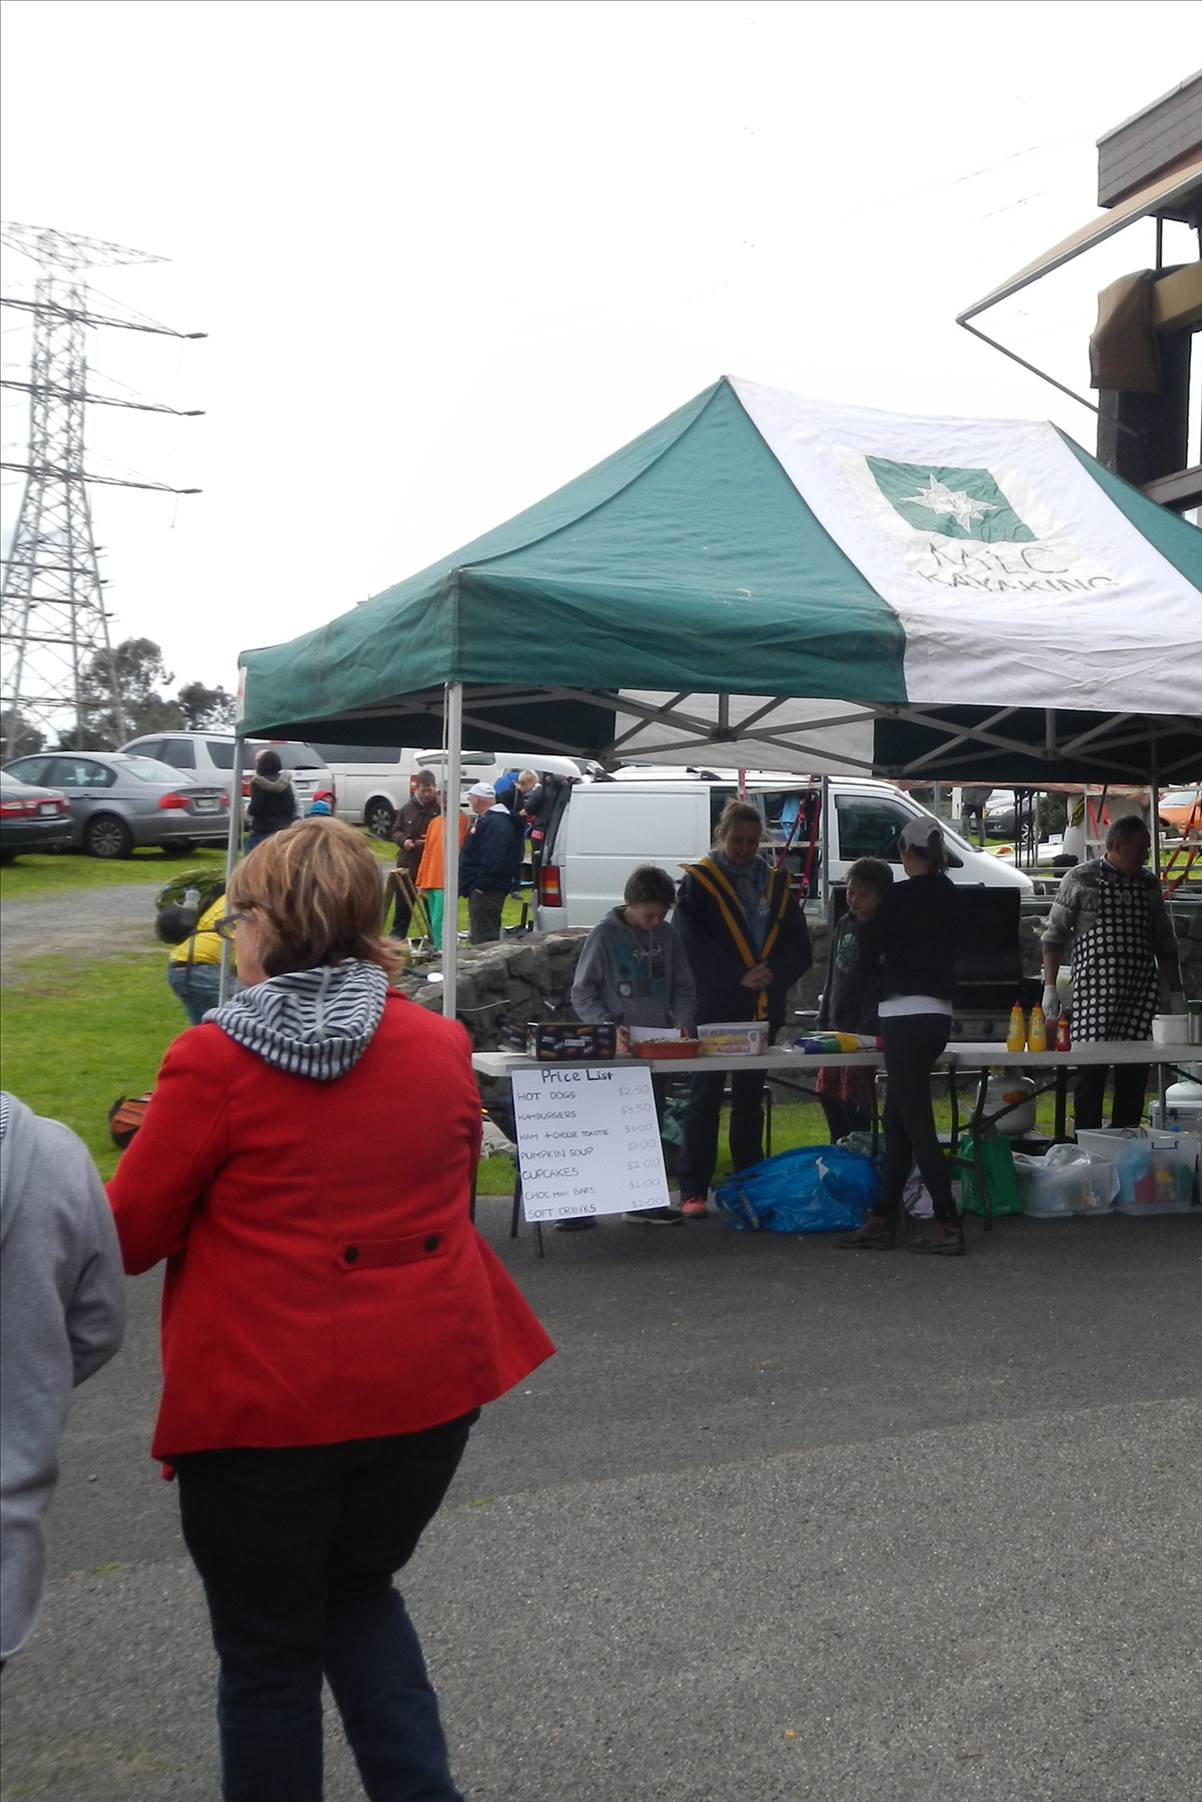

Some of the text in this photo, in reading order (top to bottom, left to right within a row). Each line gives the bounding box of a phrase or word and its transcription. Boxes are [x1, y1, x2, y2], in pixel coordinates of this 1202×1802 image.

[929, 541, 1069, 574] MLC
[917, 569, 1119, 593] KAYAKING
[541, 1068, 615, 1083] Price List
[518, 1092, 541, 1101] HOT
[550, 1090, 577, 1100] DOGS
[518, 1110, 577, 1120] HAMBURGERS
[520, 1132, 538, 1141] HAM
[520, 1149, 566, 1160] PUMPKIN
[569, 1146, 594, 1157] SOUP
[521, 1167, 580, 1180] CUPCAKES
[525, 1191, 550, 1200] CHOC
[528, 1208, 554, 1218] SOFT
[558, 1204, 597, 1215] DRINKS
